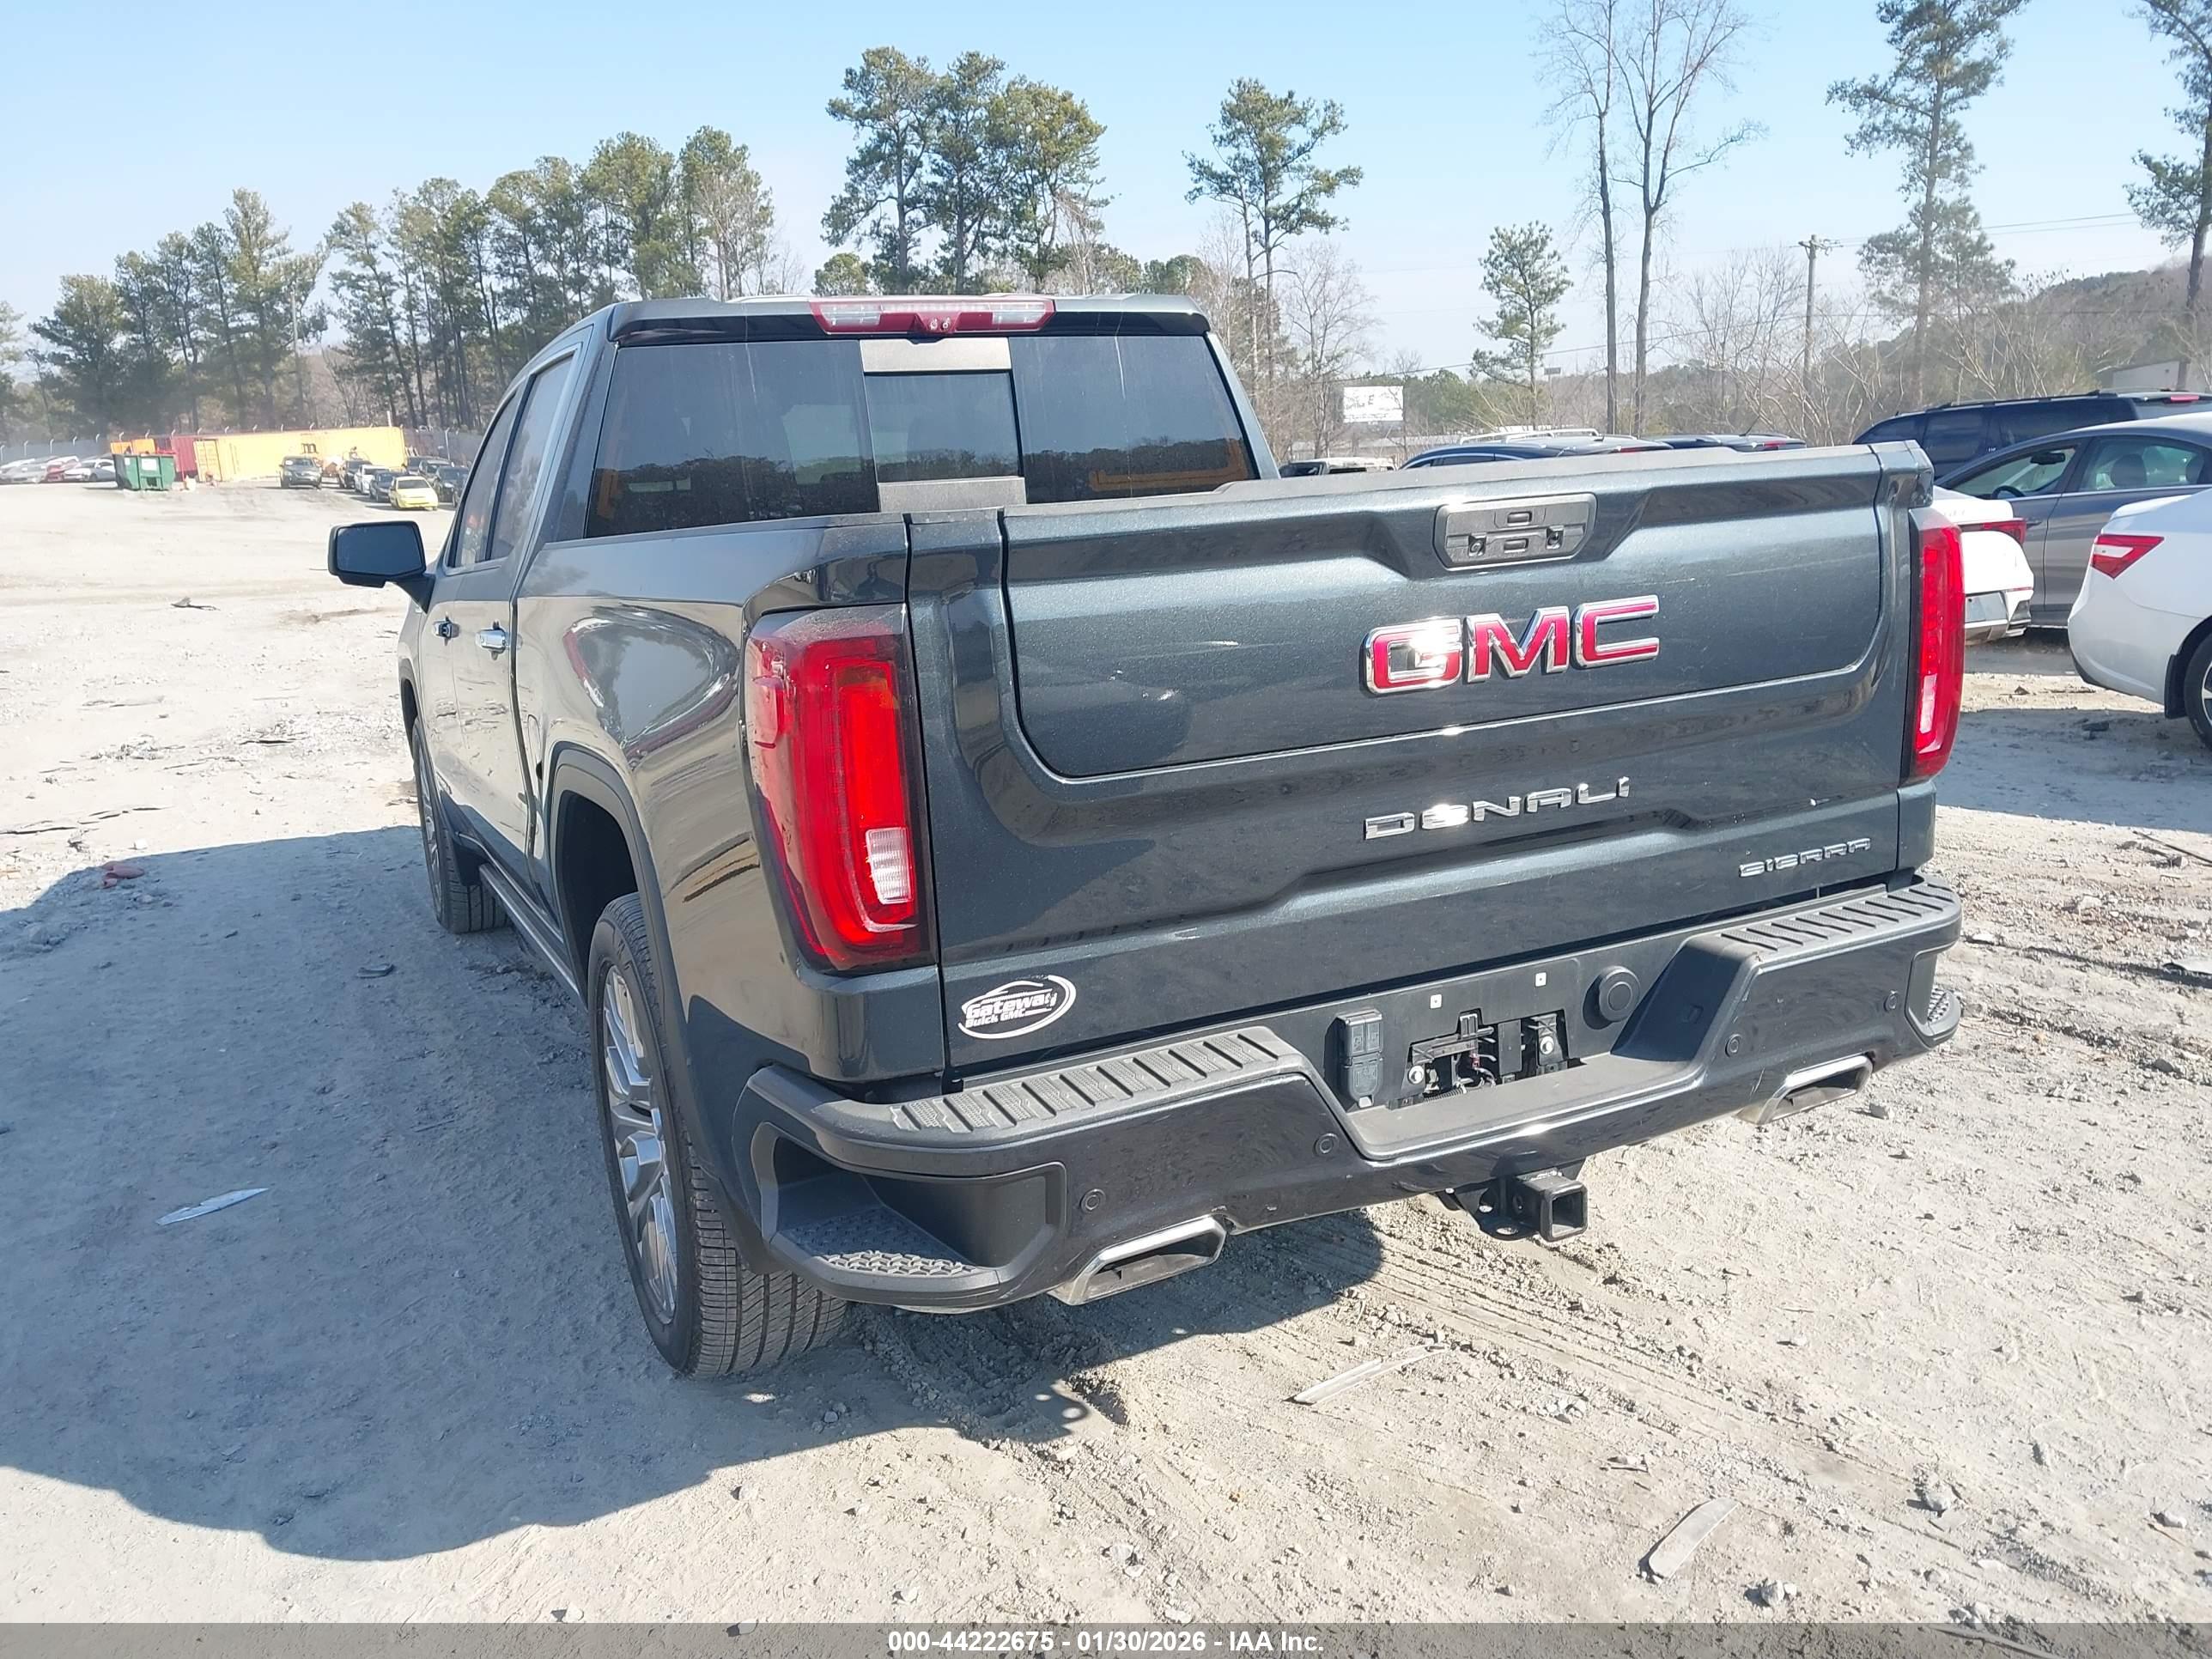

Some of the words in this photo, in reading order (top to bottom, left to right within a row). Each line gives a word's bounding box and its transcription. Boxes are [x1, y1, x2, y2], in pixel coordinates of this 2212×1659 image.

[1363, 593, 1661, 696] GMC
[1363, 775, 1632, 840] DENALI
[1738, 837, 1872, 878] SIERRA
[964, 1013, 1000, 1029] Buick
[1000, 1007, 1026, 1022] GMC
[965, 993, 1057, 1018] Gateway
